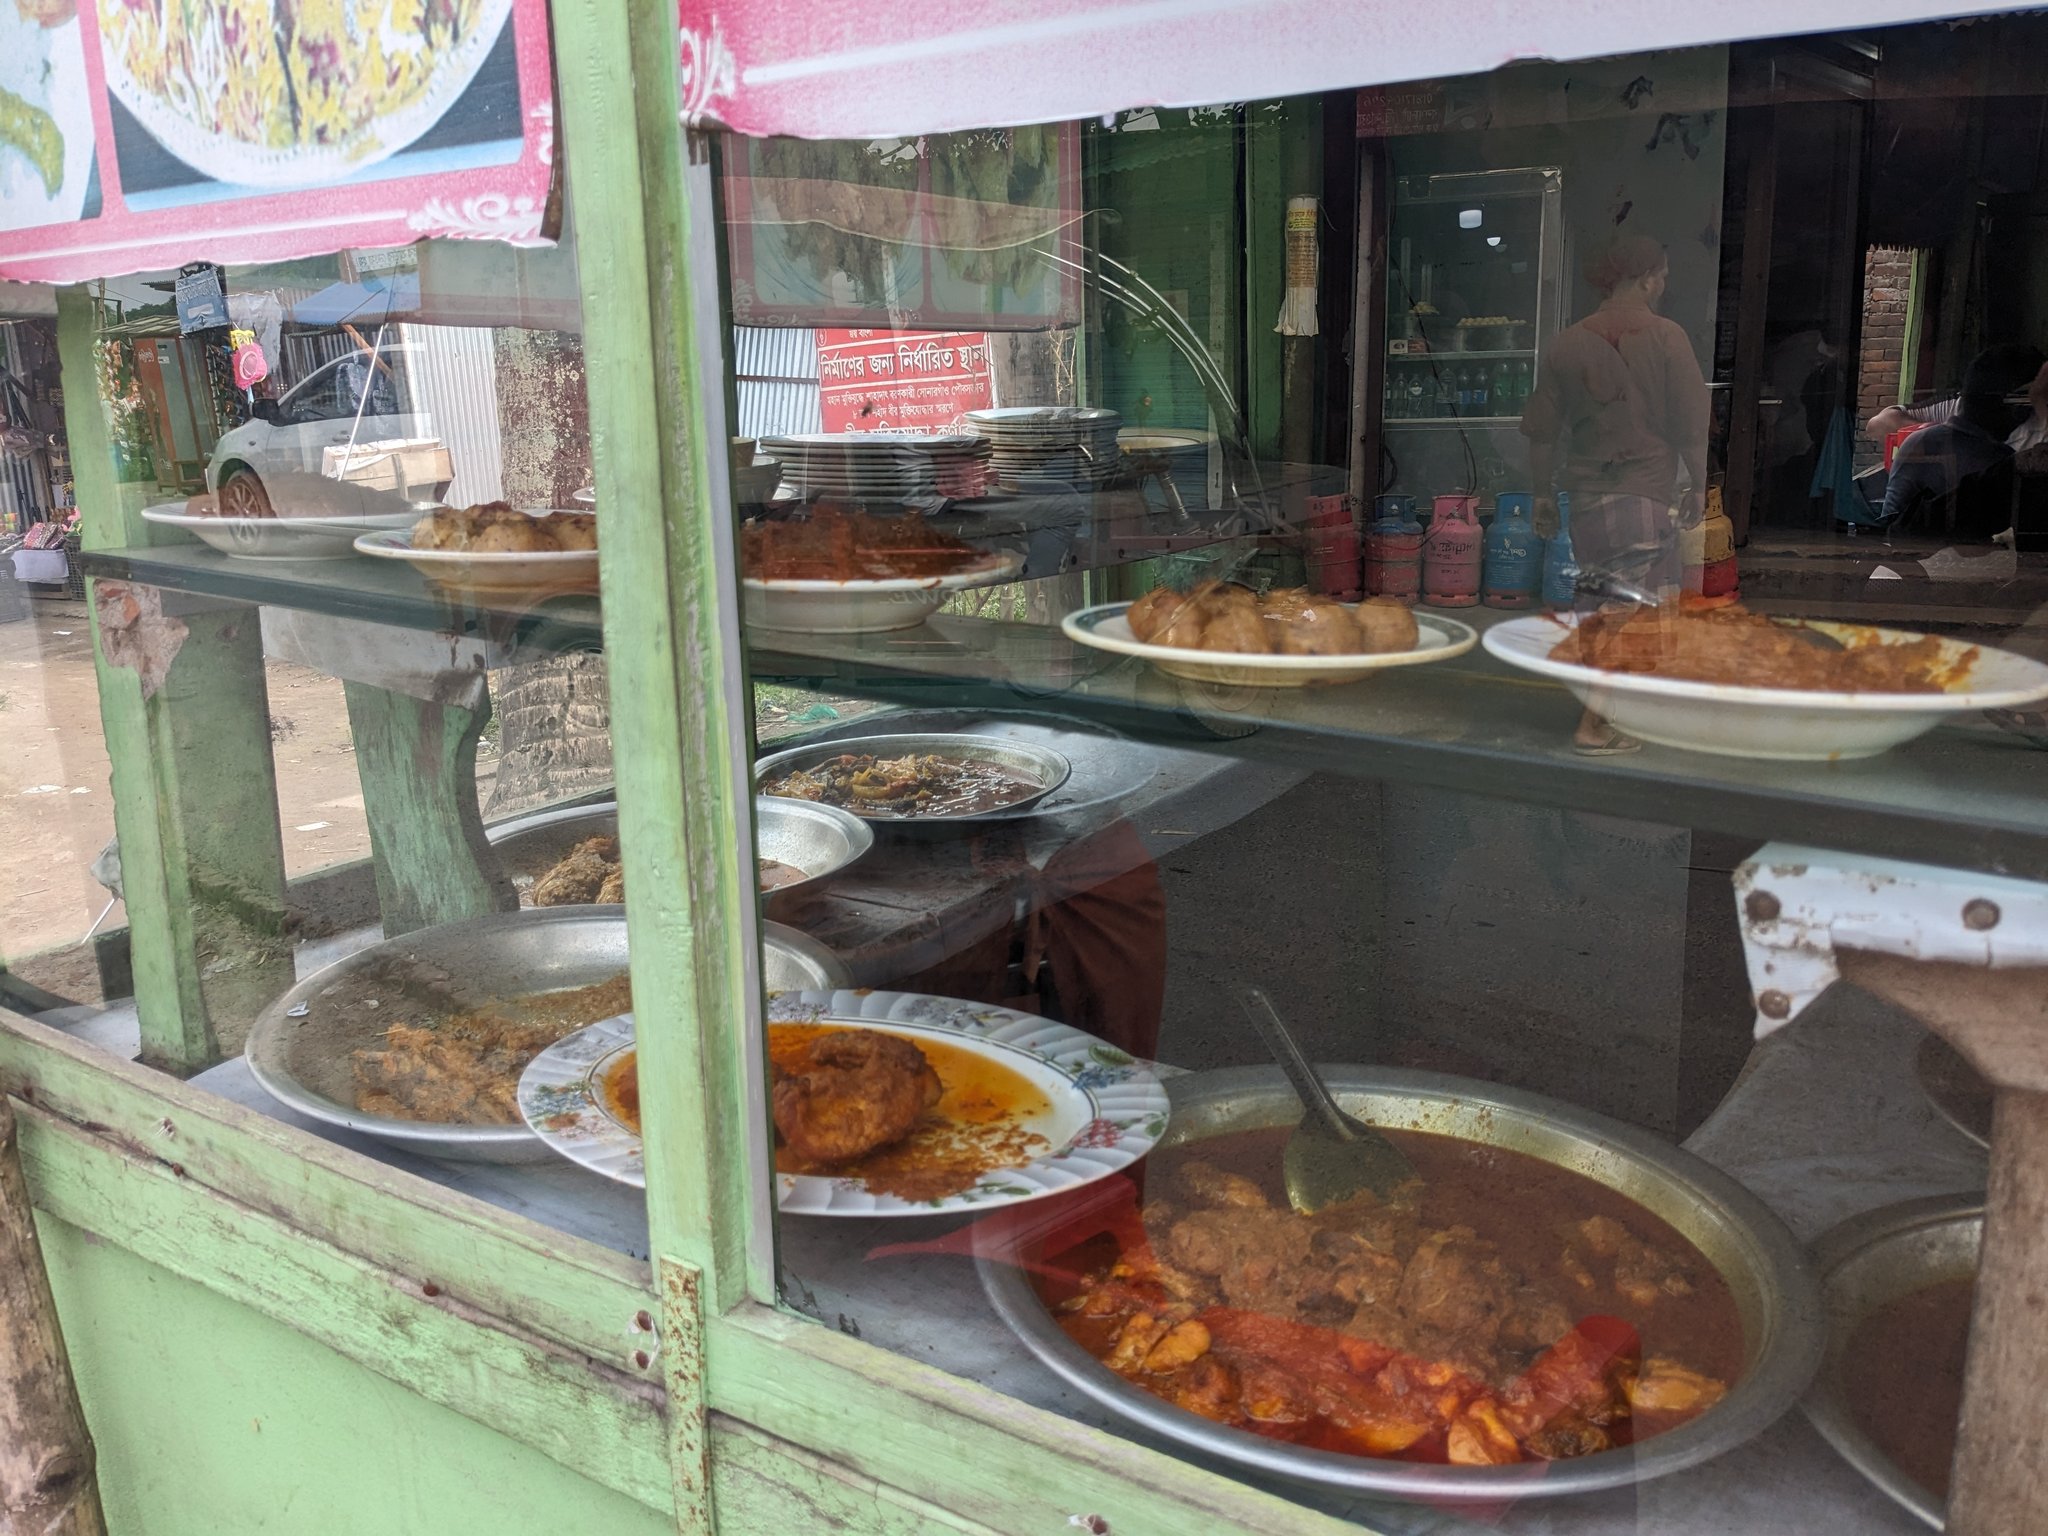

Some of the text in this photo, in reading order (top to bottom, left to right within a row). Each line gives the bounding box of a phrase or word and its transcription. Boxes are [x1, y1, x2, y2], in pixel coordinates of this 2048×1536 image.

[819, 341, 986, 381] নির্মাণের জন্য নির্ধারিত স্থান
